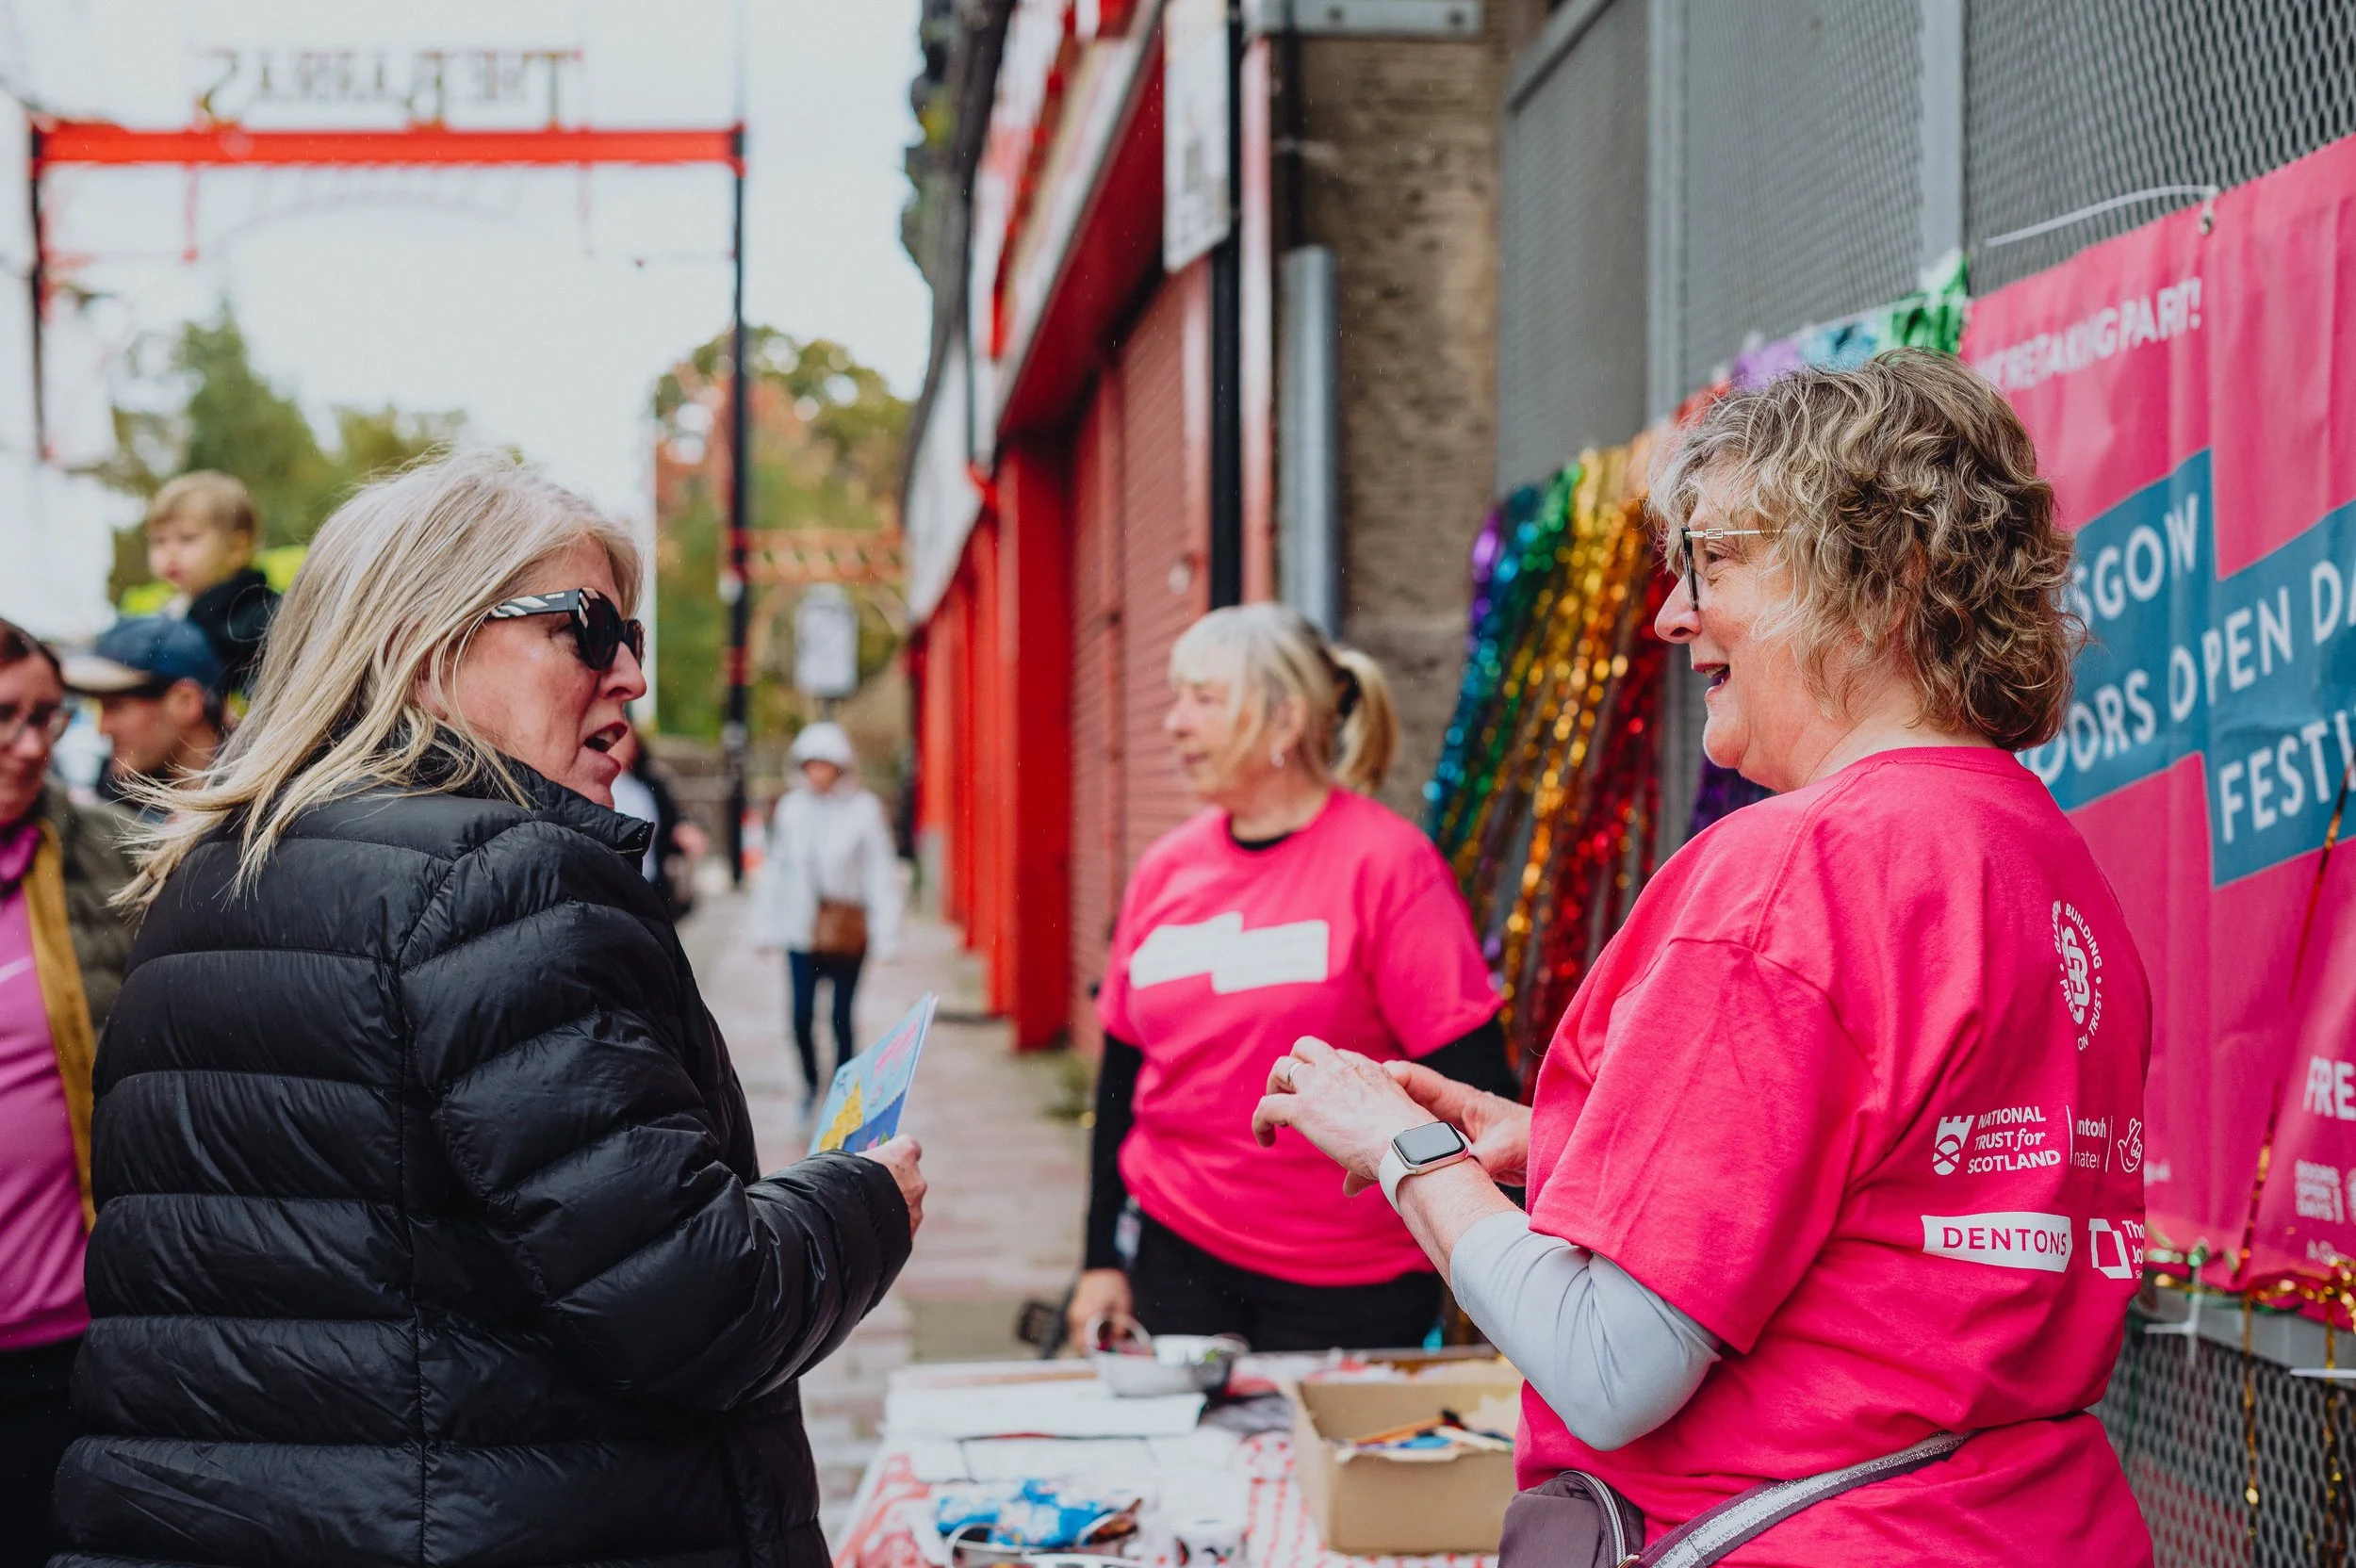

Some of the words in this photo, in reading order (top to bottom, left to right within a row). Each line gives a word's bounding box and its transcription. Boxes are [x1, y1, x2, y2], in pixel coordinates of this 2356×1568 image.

[2120, 276, 2201, 352] PART!
[2060, 492, 2199, 628] SGOW
[2014, 669, 2156, 786] OORS
[2169, 586, 2292, 724] OPEN
[2218, 705, 2356, 843] FESTI
[2065, 903, 2102, 970] BUILDING
[2087, 988, 2102, 1037] TRUST
[1974, 1131, 2015, 1152] TRUST
[2013, 1128, 2046, 1152] for
[1978, 1106, 2046, 1129] NATIONAL
[1967, 1150, 2061, 1174] SCOTLAND
[1942, 1226, 2068, 1257] DENTONS
